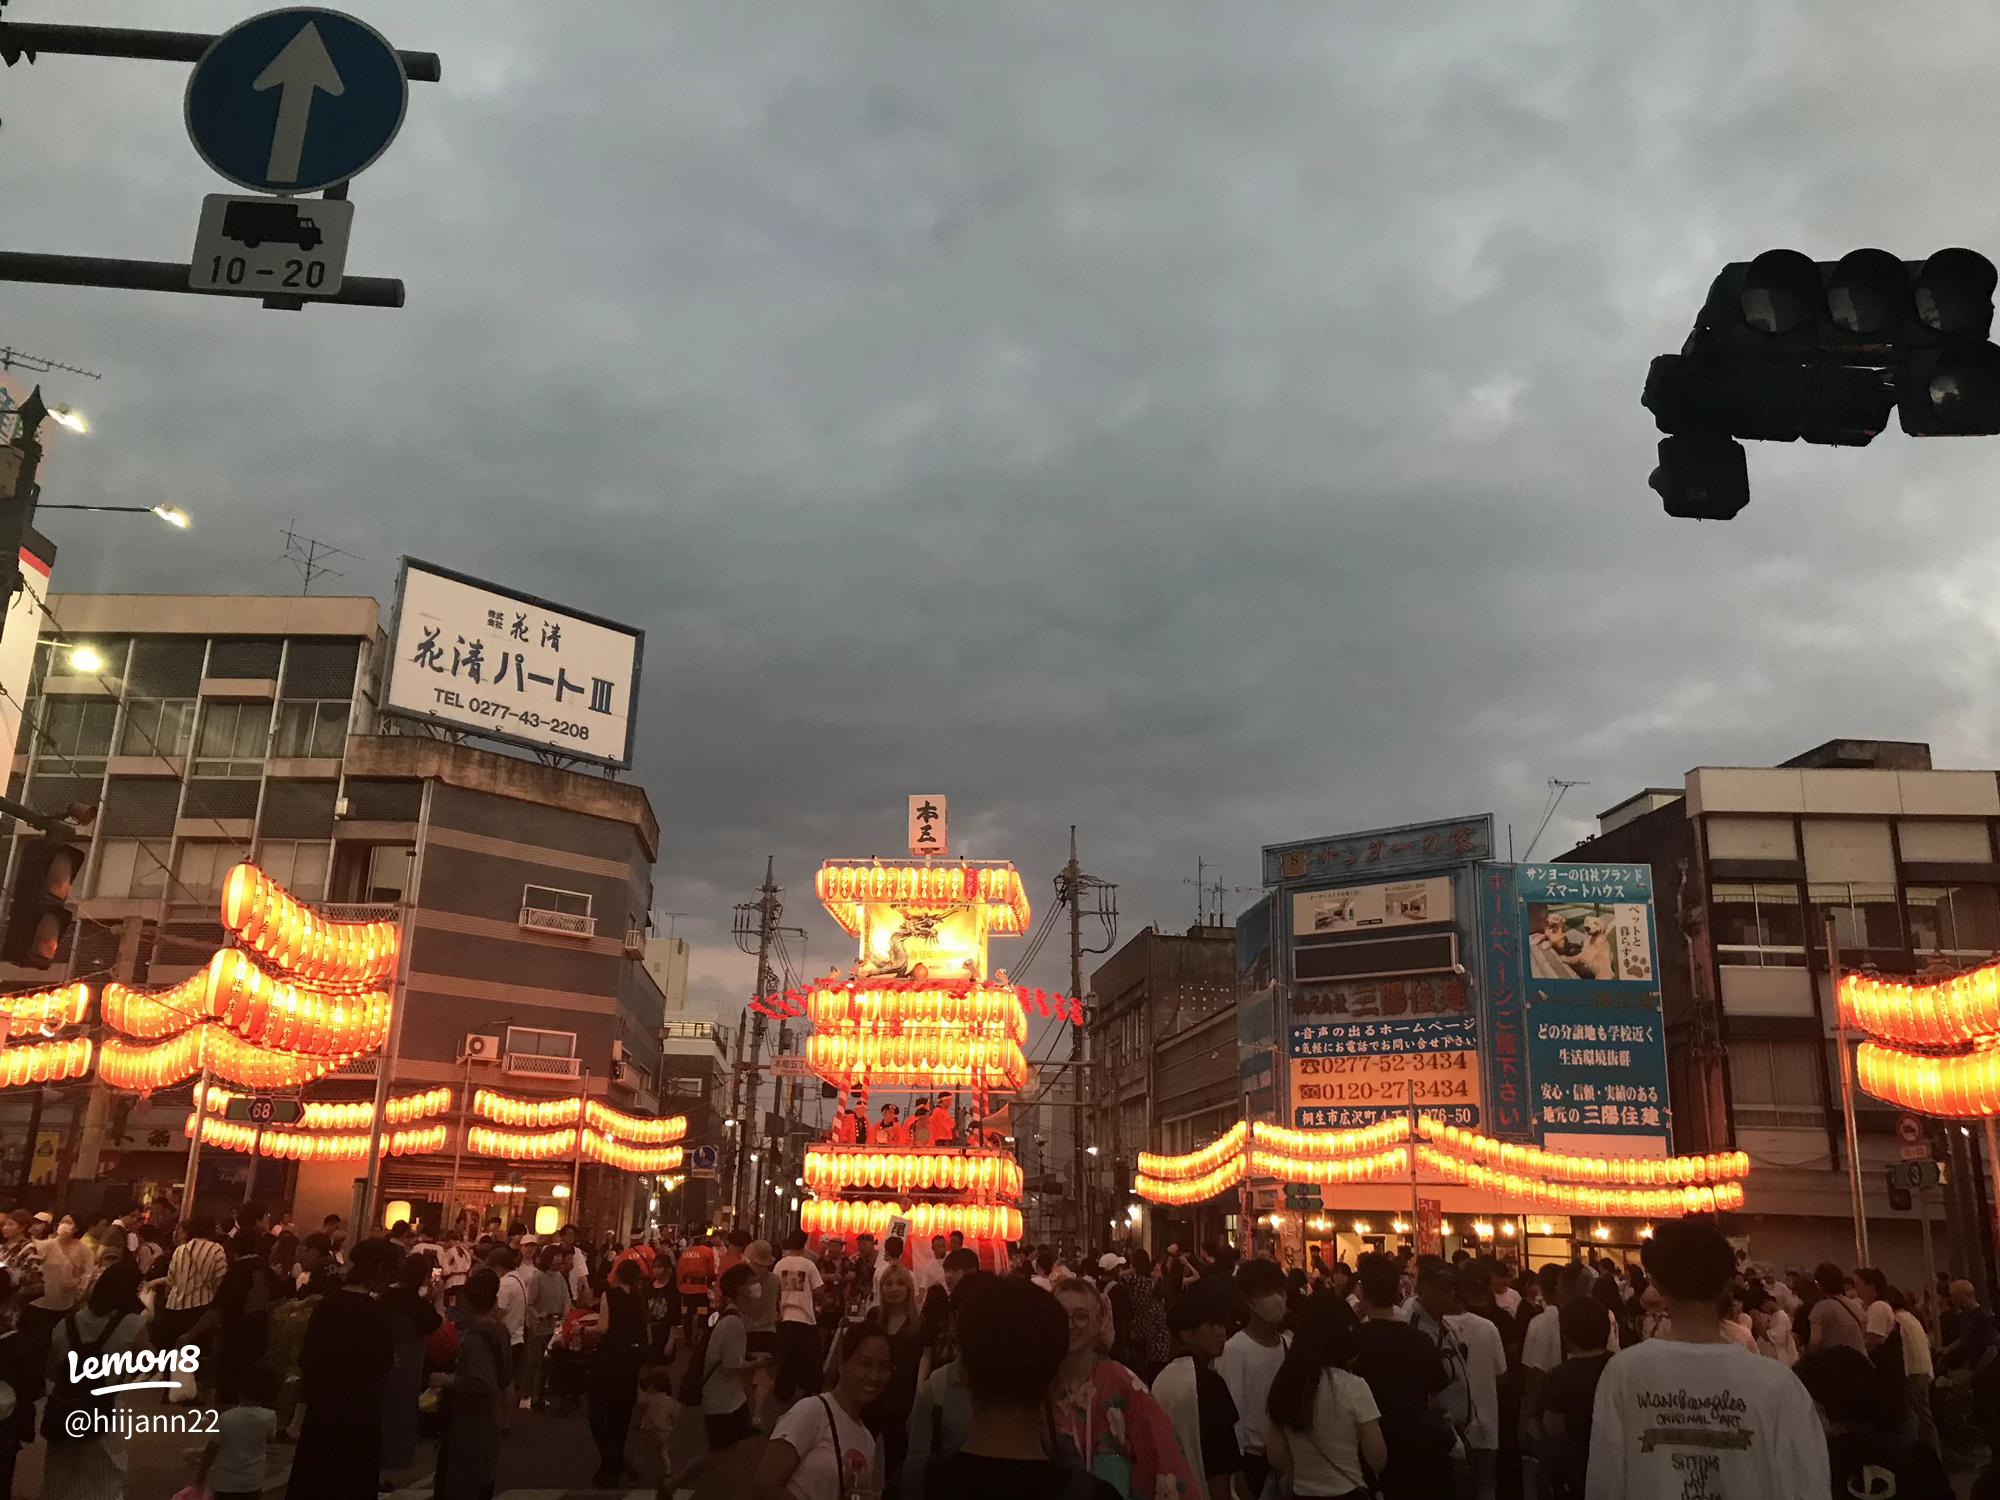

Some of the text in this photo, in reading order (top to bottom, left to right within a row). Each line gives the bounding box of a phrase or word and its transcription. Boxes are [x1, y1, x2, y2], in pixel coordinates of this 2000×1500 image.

[210, 255, 325, 288] 10-20
[510, 612, 562, 652] 花清
[434, 688, 590, 740] TEL 0277-43-2208
[1526, 868, 1643, 882] サンヨーの自社ブランド
[1545, 883, 1625, 898] スマートハウス
[1301, 1017, 1477, 1040] 音声の出るホームページ
[1538, 1023, 1653, 1042] どの分譲地も学校近く
[1321, 1051, 1467, 1074] 0277-52-3434
[1559, 1047, 1631, 1067] 生活環境抜群
[1322, 1079, 1469, 1101] 0120-27-3434
[252, 1102, 271, 1119] 68
[1717, 1413, 1742, 1429] ART
